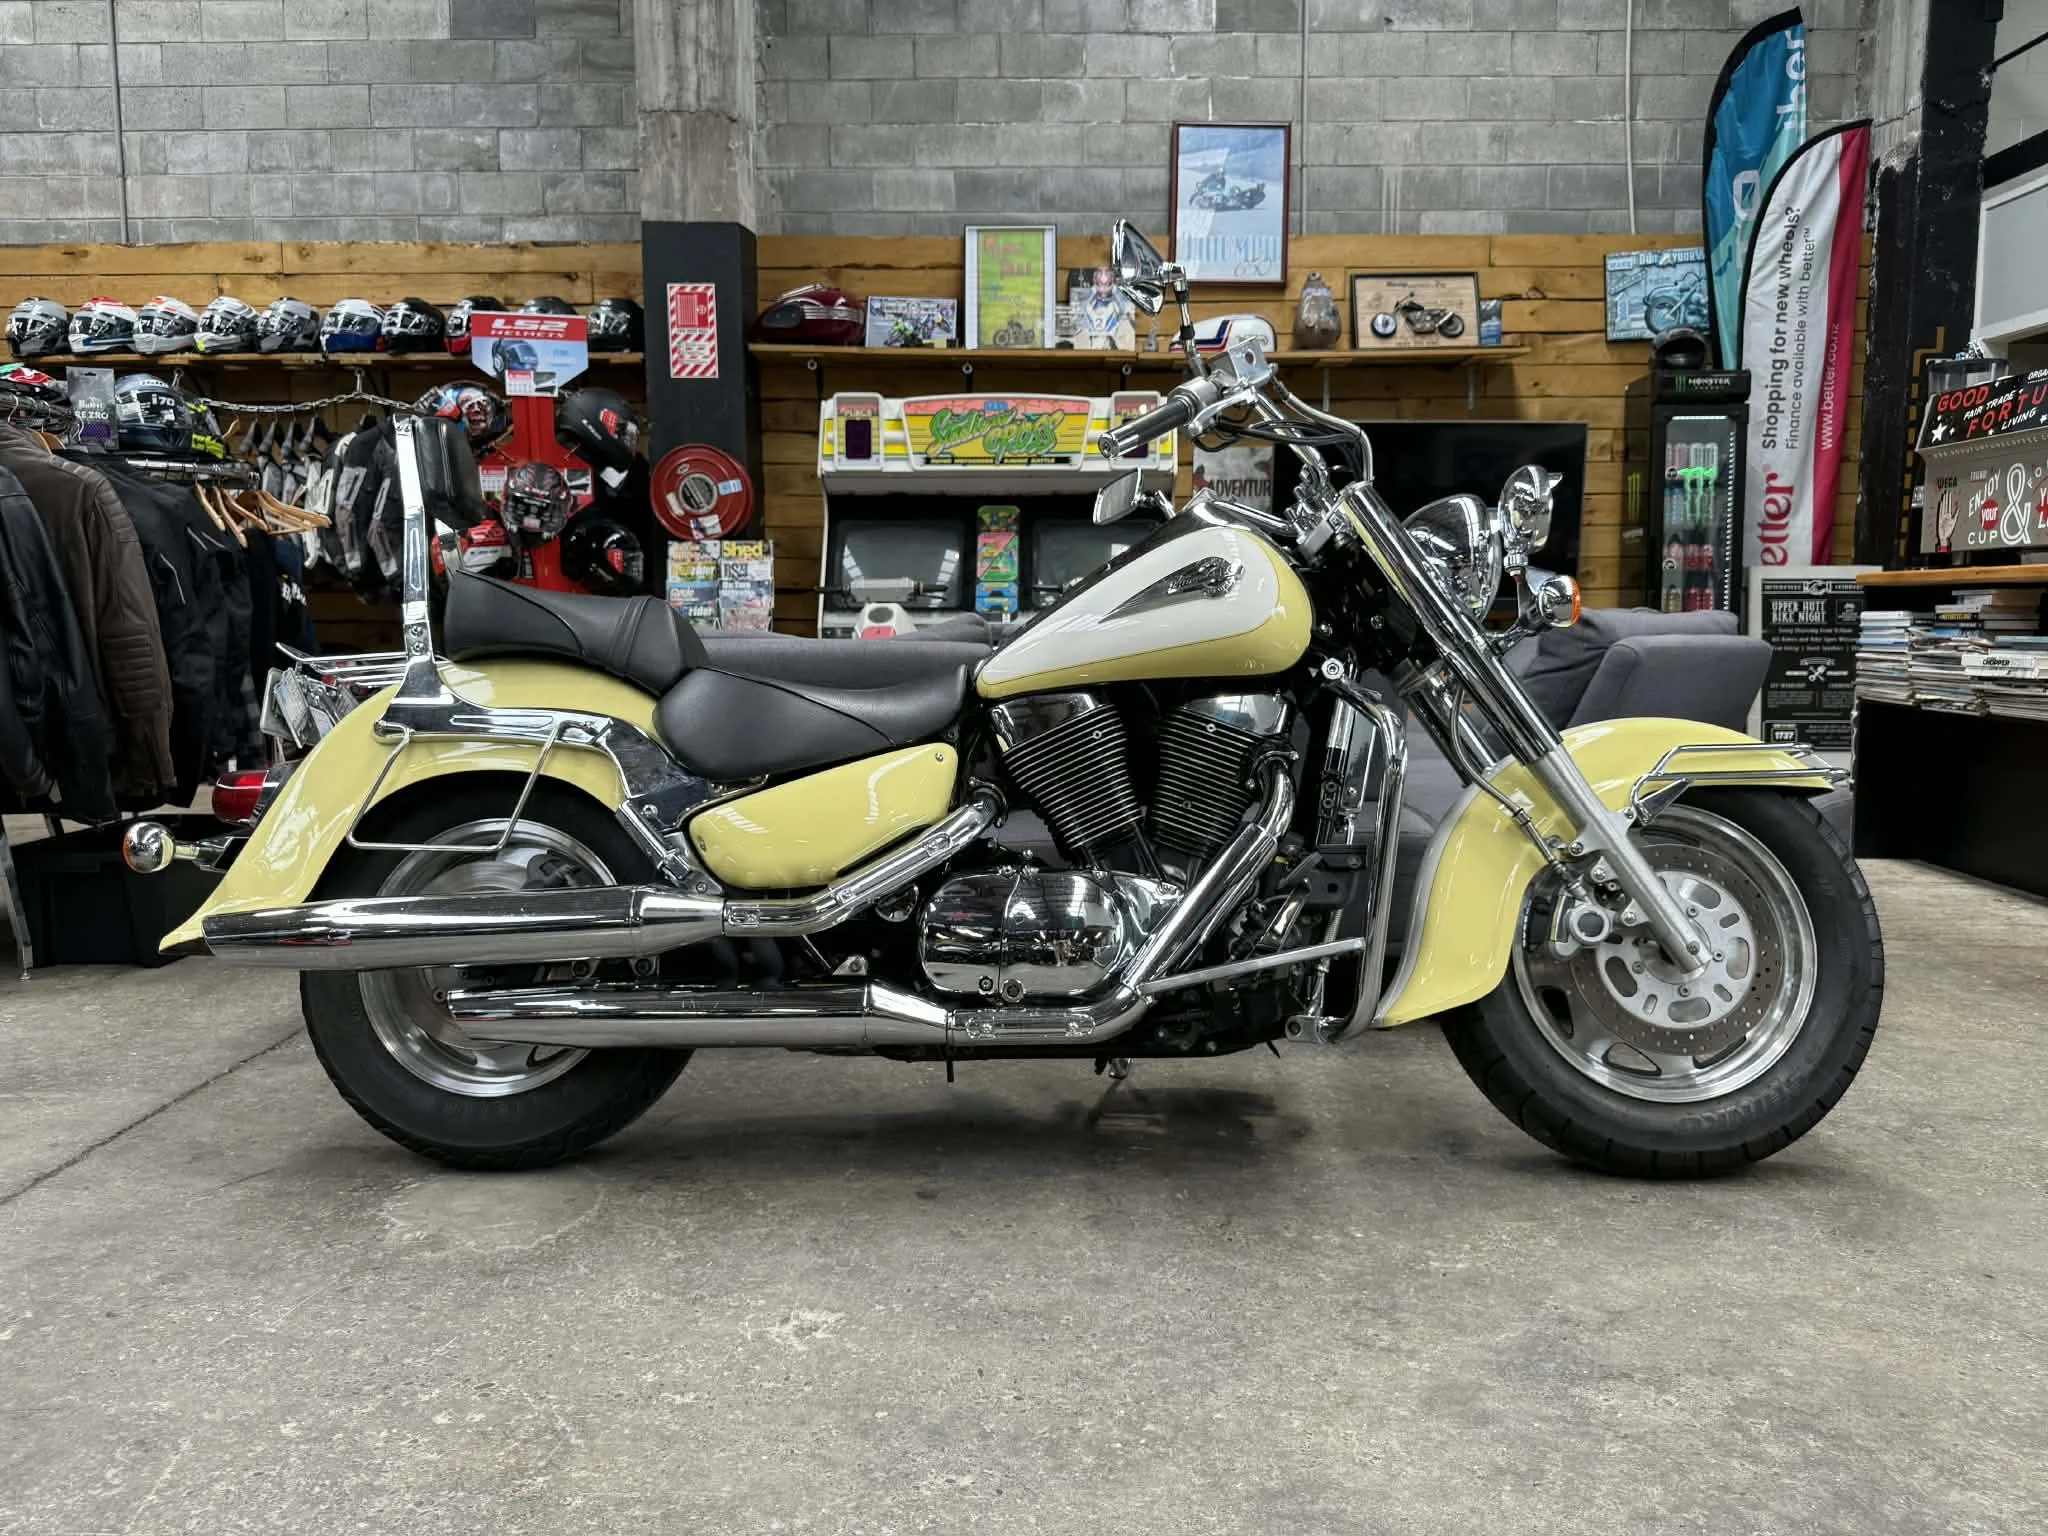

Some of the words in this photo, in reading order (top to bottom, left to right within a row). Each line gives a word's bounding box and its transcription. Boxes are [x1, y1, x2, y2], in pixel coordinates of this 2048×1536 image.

[1778, 206, 1801, 280] wheels?
[1776, 283, 1790, 323] new
[1796, 289, 1809, 318] with
[491, 329, 565, 338] HELMETS
[492, 318, 568, 332] LS2
[1769, 328, 1788, 353] for
[1792, 320, 1807, 388] available
[1762, 359, 1790, 449] Shopping
[1937, 385, 1989, 412] GOOD
[1963, 405, 1983, 420] FAIR
[1985, 389, 2017, 410] TRADE
[1786, 392, 1802, 449] Finance
[2001, 407, 2037, 431] LIVING
[1968, 468, 2000, 517] ENJOY
[2000, 463, 2031, 545] &
[1981, 507, 1998, 528] your
[723, 540, 763, 557] Shed
[1968, 530, 1998, 545] CUP
[1771, 600, 1799, 612] UPPER
[1803, 600, 1825, 612] HUTT
[1771, 611, 1794, 623] BIKE
[1798, 611, 1826, 623] NIGHT
